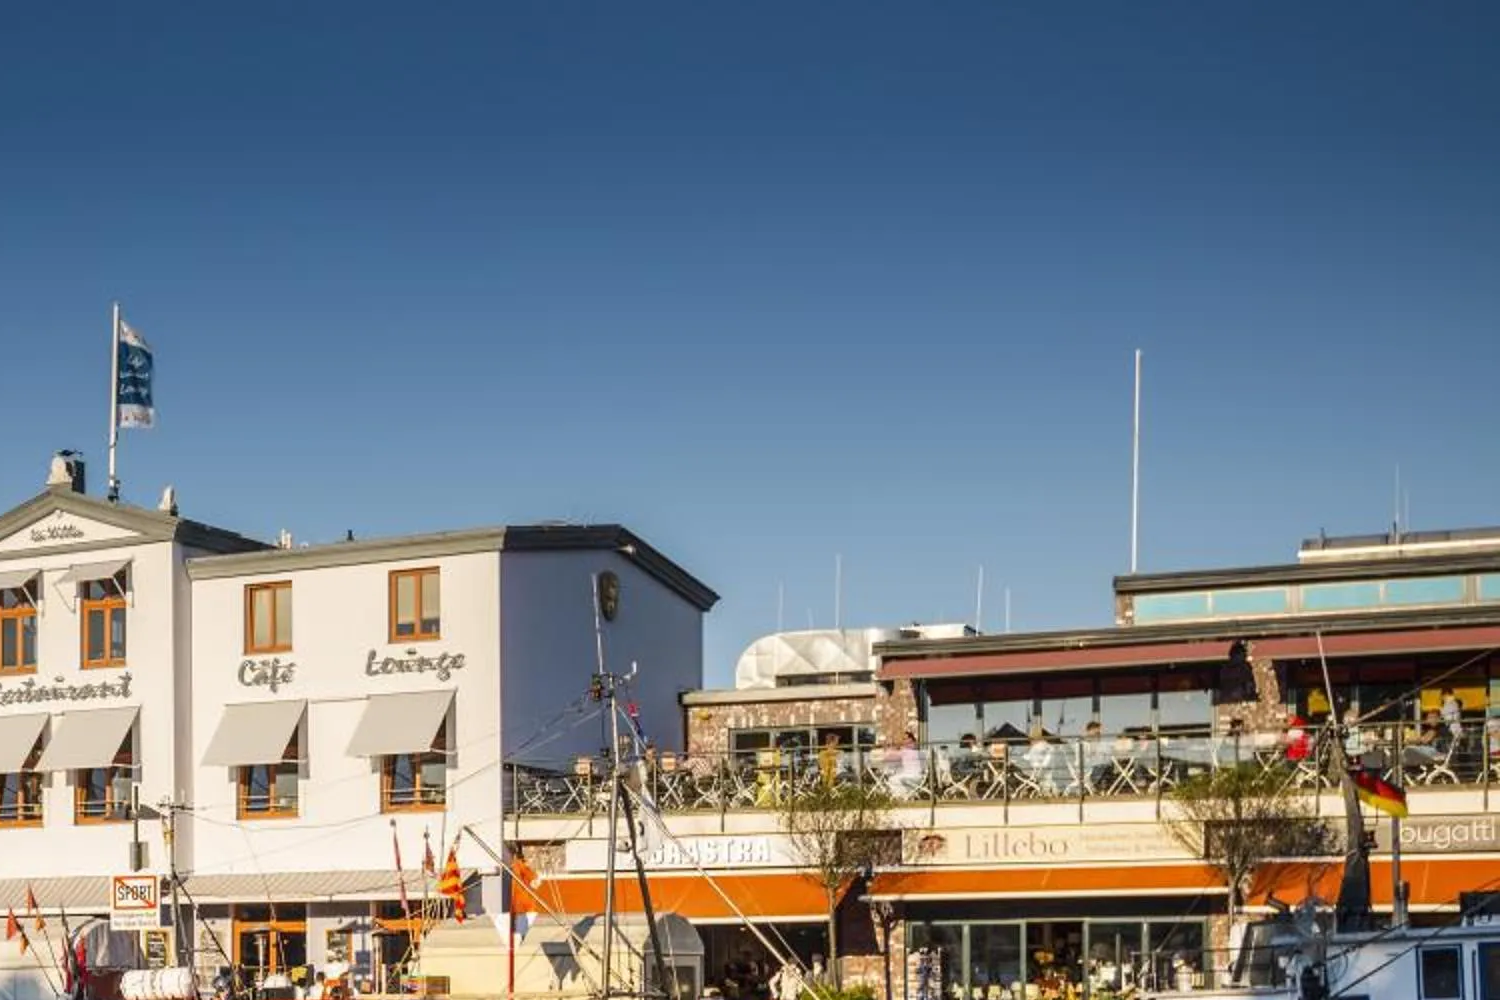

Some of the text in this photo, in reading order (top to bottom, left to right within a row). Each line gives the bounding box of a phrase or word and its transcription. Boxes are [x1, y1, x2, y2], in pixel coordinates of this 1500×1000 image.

[365, 649, 466, 682] Lounge
[965, 832, 1069, 859] Lillebo
[1399, 816, 1496, 849] bugatti
[117, 884, 152, 901] SPORT
